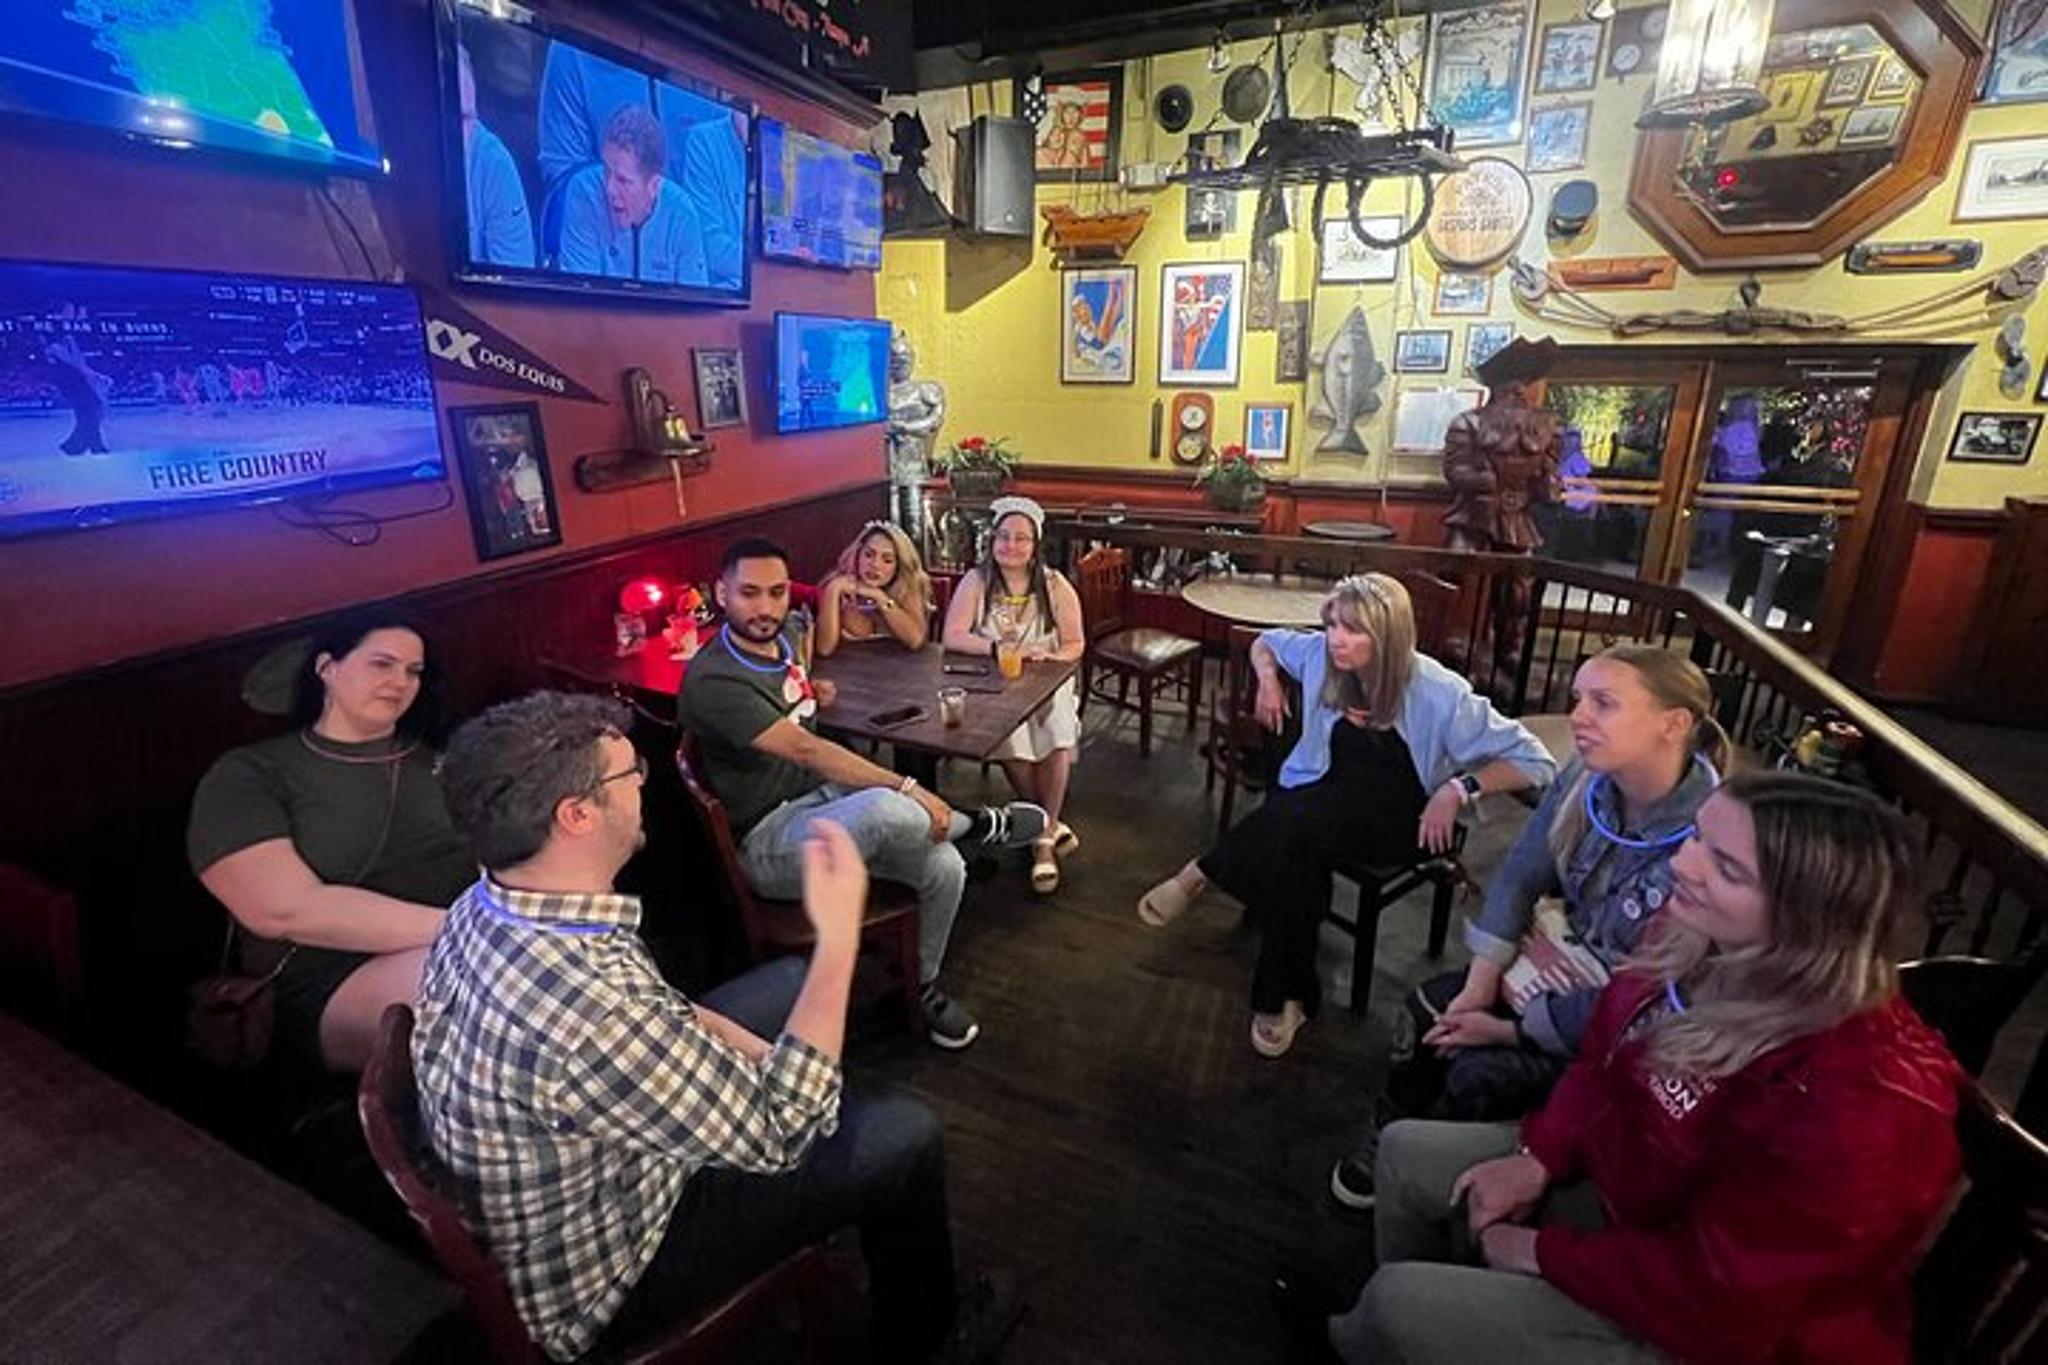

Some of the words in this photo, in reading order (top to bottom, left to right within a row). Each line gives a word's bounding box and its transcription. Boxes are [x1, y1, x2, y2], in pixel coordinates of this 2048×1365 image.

[479, 347, 516, 374] DOS
[517, 363, 566, 393] EQUIS
[148, 459, 214, 490] FIRE
[218, 449, 328, 482] COUNTRY
